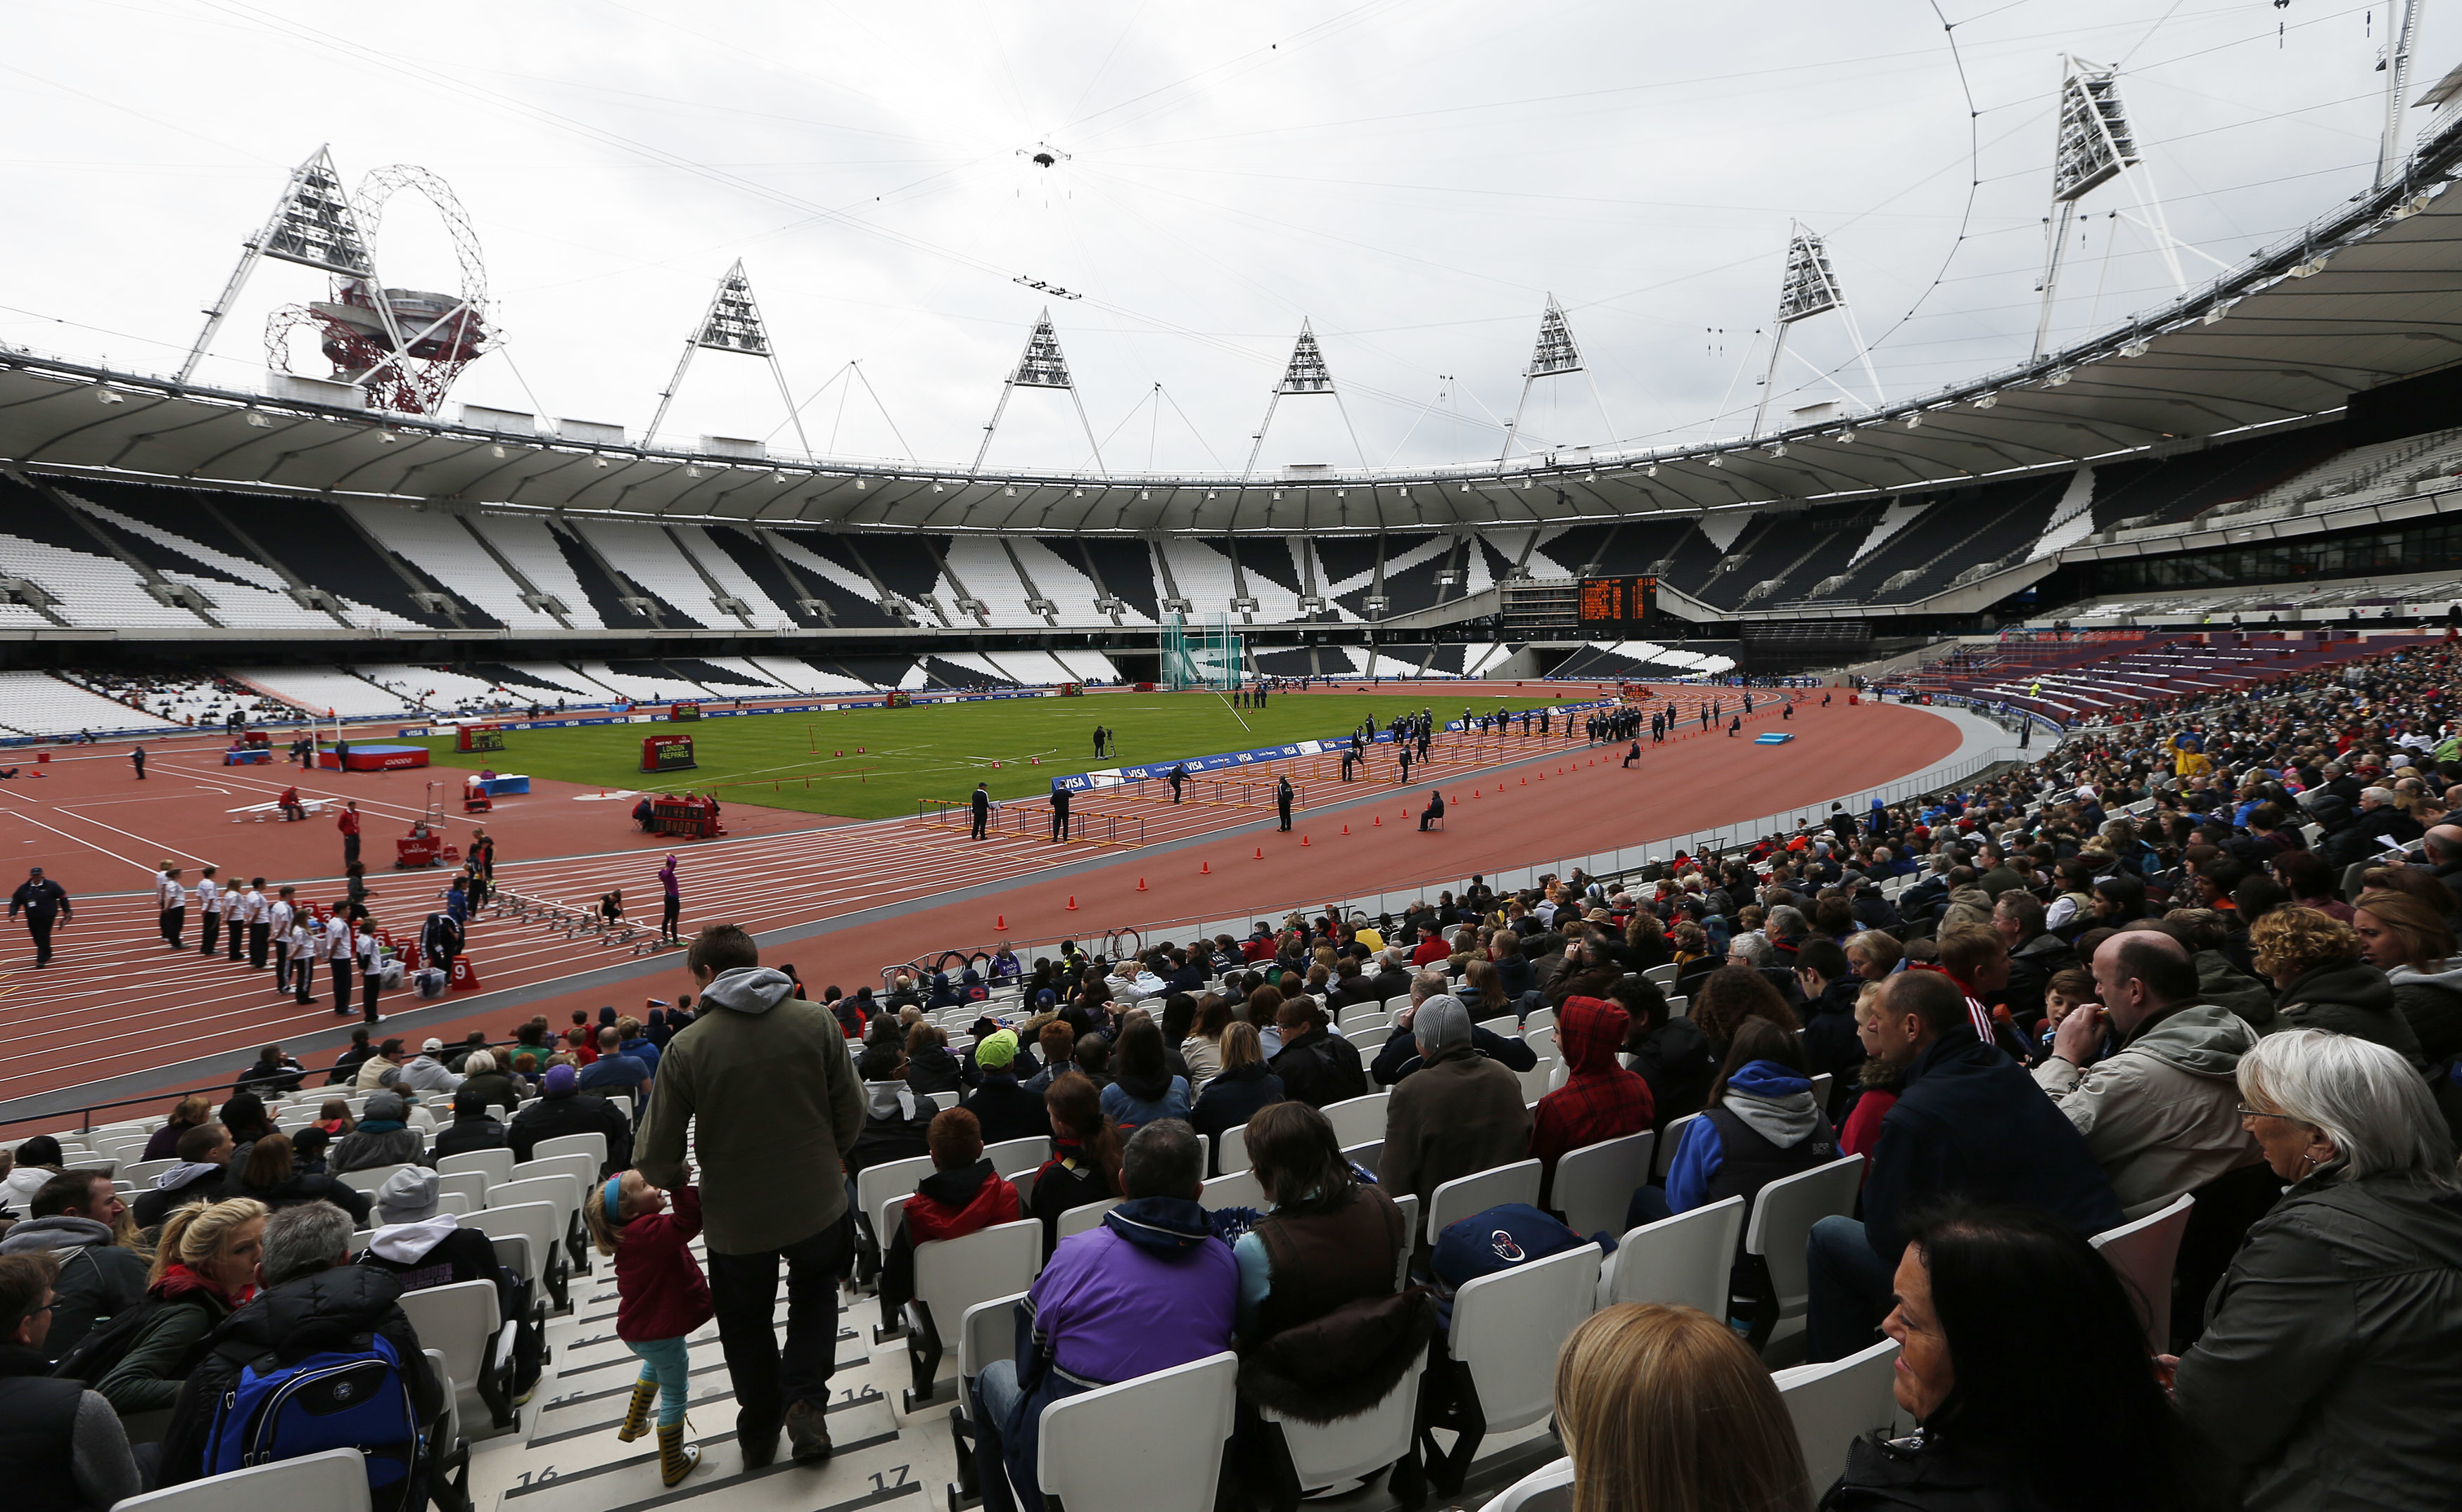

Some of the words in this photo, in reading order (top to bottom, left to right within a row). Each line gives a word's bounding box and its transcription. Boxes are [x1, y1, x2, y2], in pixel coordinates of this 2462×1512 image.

[659, 750, 689, 760] PREPARES
[1282, 746, 1297, 755] VISA
[1236, 753, 1254, 763] VISA
[1185, 760, 1205, 771] VISA
[1127, 768, 1149, 779] VISA
[375, 935, 385, 947] 6
[398, 945, 409, 959] 7
[454, 964, 466, 980] 9
[1354, 1162, 1365, 1171] VISA
[1498, 1234, 1519, 1255] FLORA
[841, 1383, 877, 1402] 16
[516, 1464, 558, 1487] 16
[868, 1464, 910, 1494] 17
